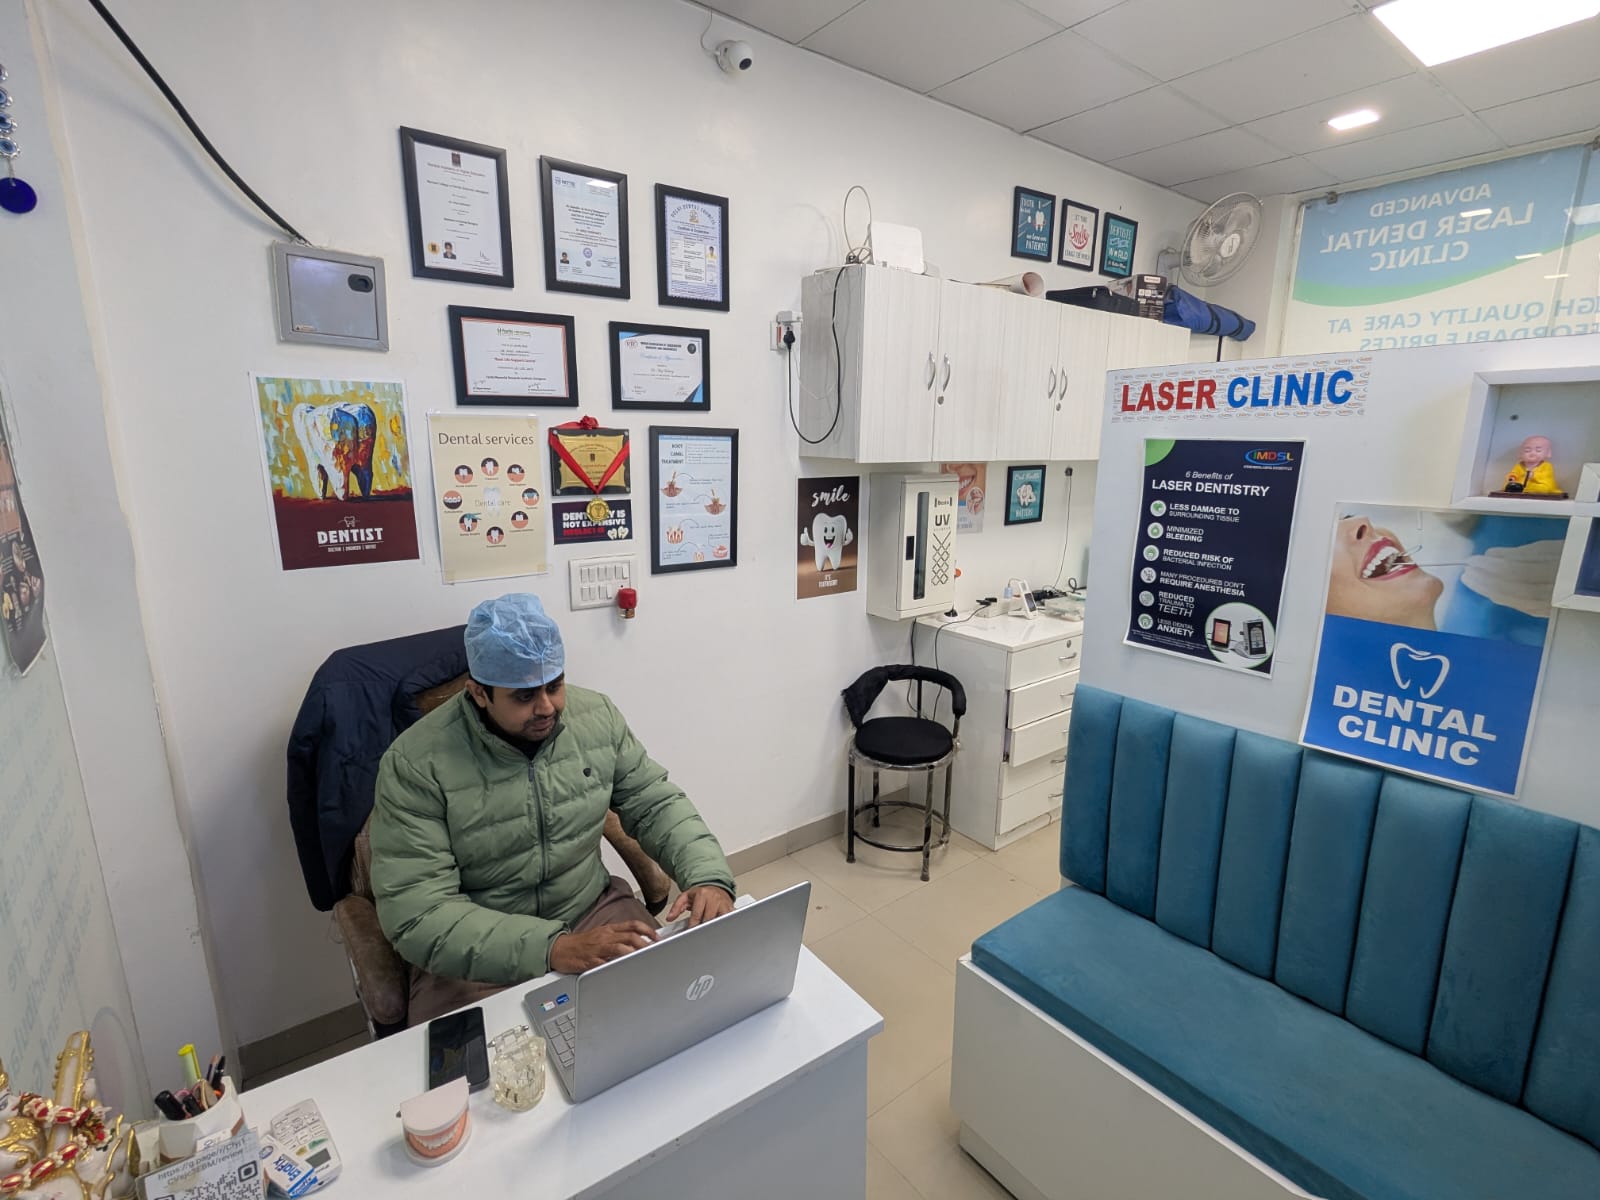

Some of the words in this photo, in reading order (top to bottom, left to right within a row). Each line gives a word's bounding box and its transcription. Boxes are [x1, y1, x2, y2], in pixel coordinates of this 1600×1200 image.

[1121, 378, 1217, 412] LASER
[1227, 370, 1354, 409] CLINIC
[438, 433, 482, 446] Dental
[484, 433, 534, 446] services
[1192, 472, 1223, 480] Benefits
[1224, 472, 1233, 480] of
[1151, 479, 1192, 492] LASER
[1195, 481, 1270, 497] DENTISTRY
[811, 484, 851, 507] smile
[562, 510, 615, 521] DENTY
[616, 510, 626, 518] IS
[1169, 503, 1190, 512] LESS
[1191, 505, 1226, 515] DAMAGE
[1228, 508, 1240, 516] TO
[562, 520, 581, 528] NOT
[582, 519, 626, 528] EXPENSIVE
[935, 514, 950, 526] UV
[1168, 511, 1215, 522] SURROUNDING
[1216, 515, 1240, 523] TISSUE
[317, 528, 384, 544] DENTIST
[1165, 532, 1203, 542] BLEEDING
[1166, 525, 1204, 536] MINIMIZED
[1162, 556, 1196, 566] BACTERIAL
[1197, 560, 1232, 570] INFECTION
[1163, 549, 1200, 560] REDUCED
[1201, 553, 1221, 562] RISK
[1222, 556, 1235, 564] OF
[1160, 571, 1178, 579] MANY
[1178, 573, 1223, 586] PROCEDURES
[1160, 578, 1193, 589] REQUIRE
[1194, 582, 1246, 597] ANESTHESIA
[1158, 591, 1195, 603] REDUCED
[1158, 597, 1184, 608] TRAUMA
[1185, 602, 1194, 610] TO
[1158, 604, 1193, 618] TEETH
[1156, 624, 1195, 638] ANXIETY
[1172, 620, 1194, 630] DENTAL
[1332, 684, 1497, 742] DENTAL
[1337, 715, 1480, 766] CLINIC
[687, 974, 714, 1001] hp
